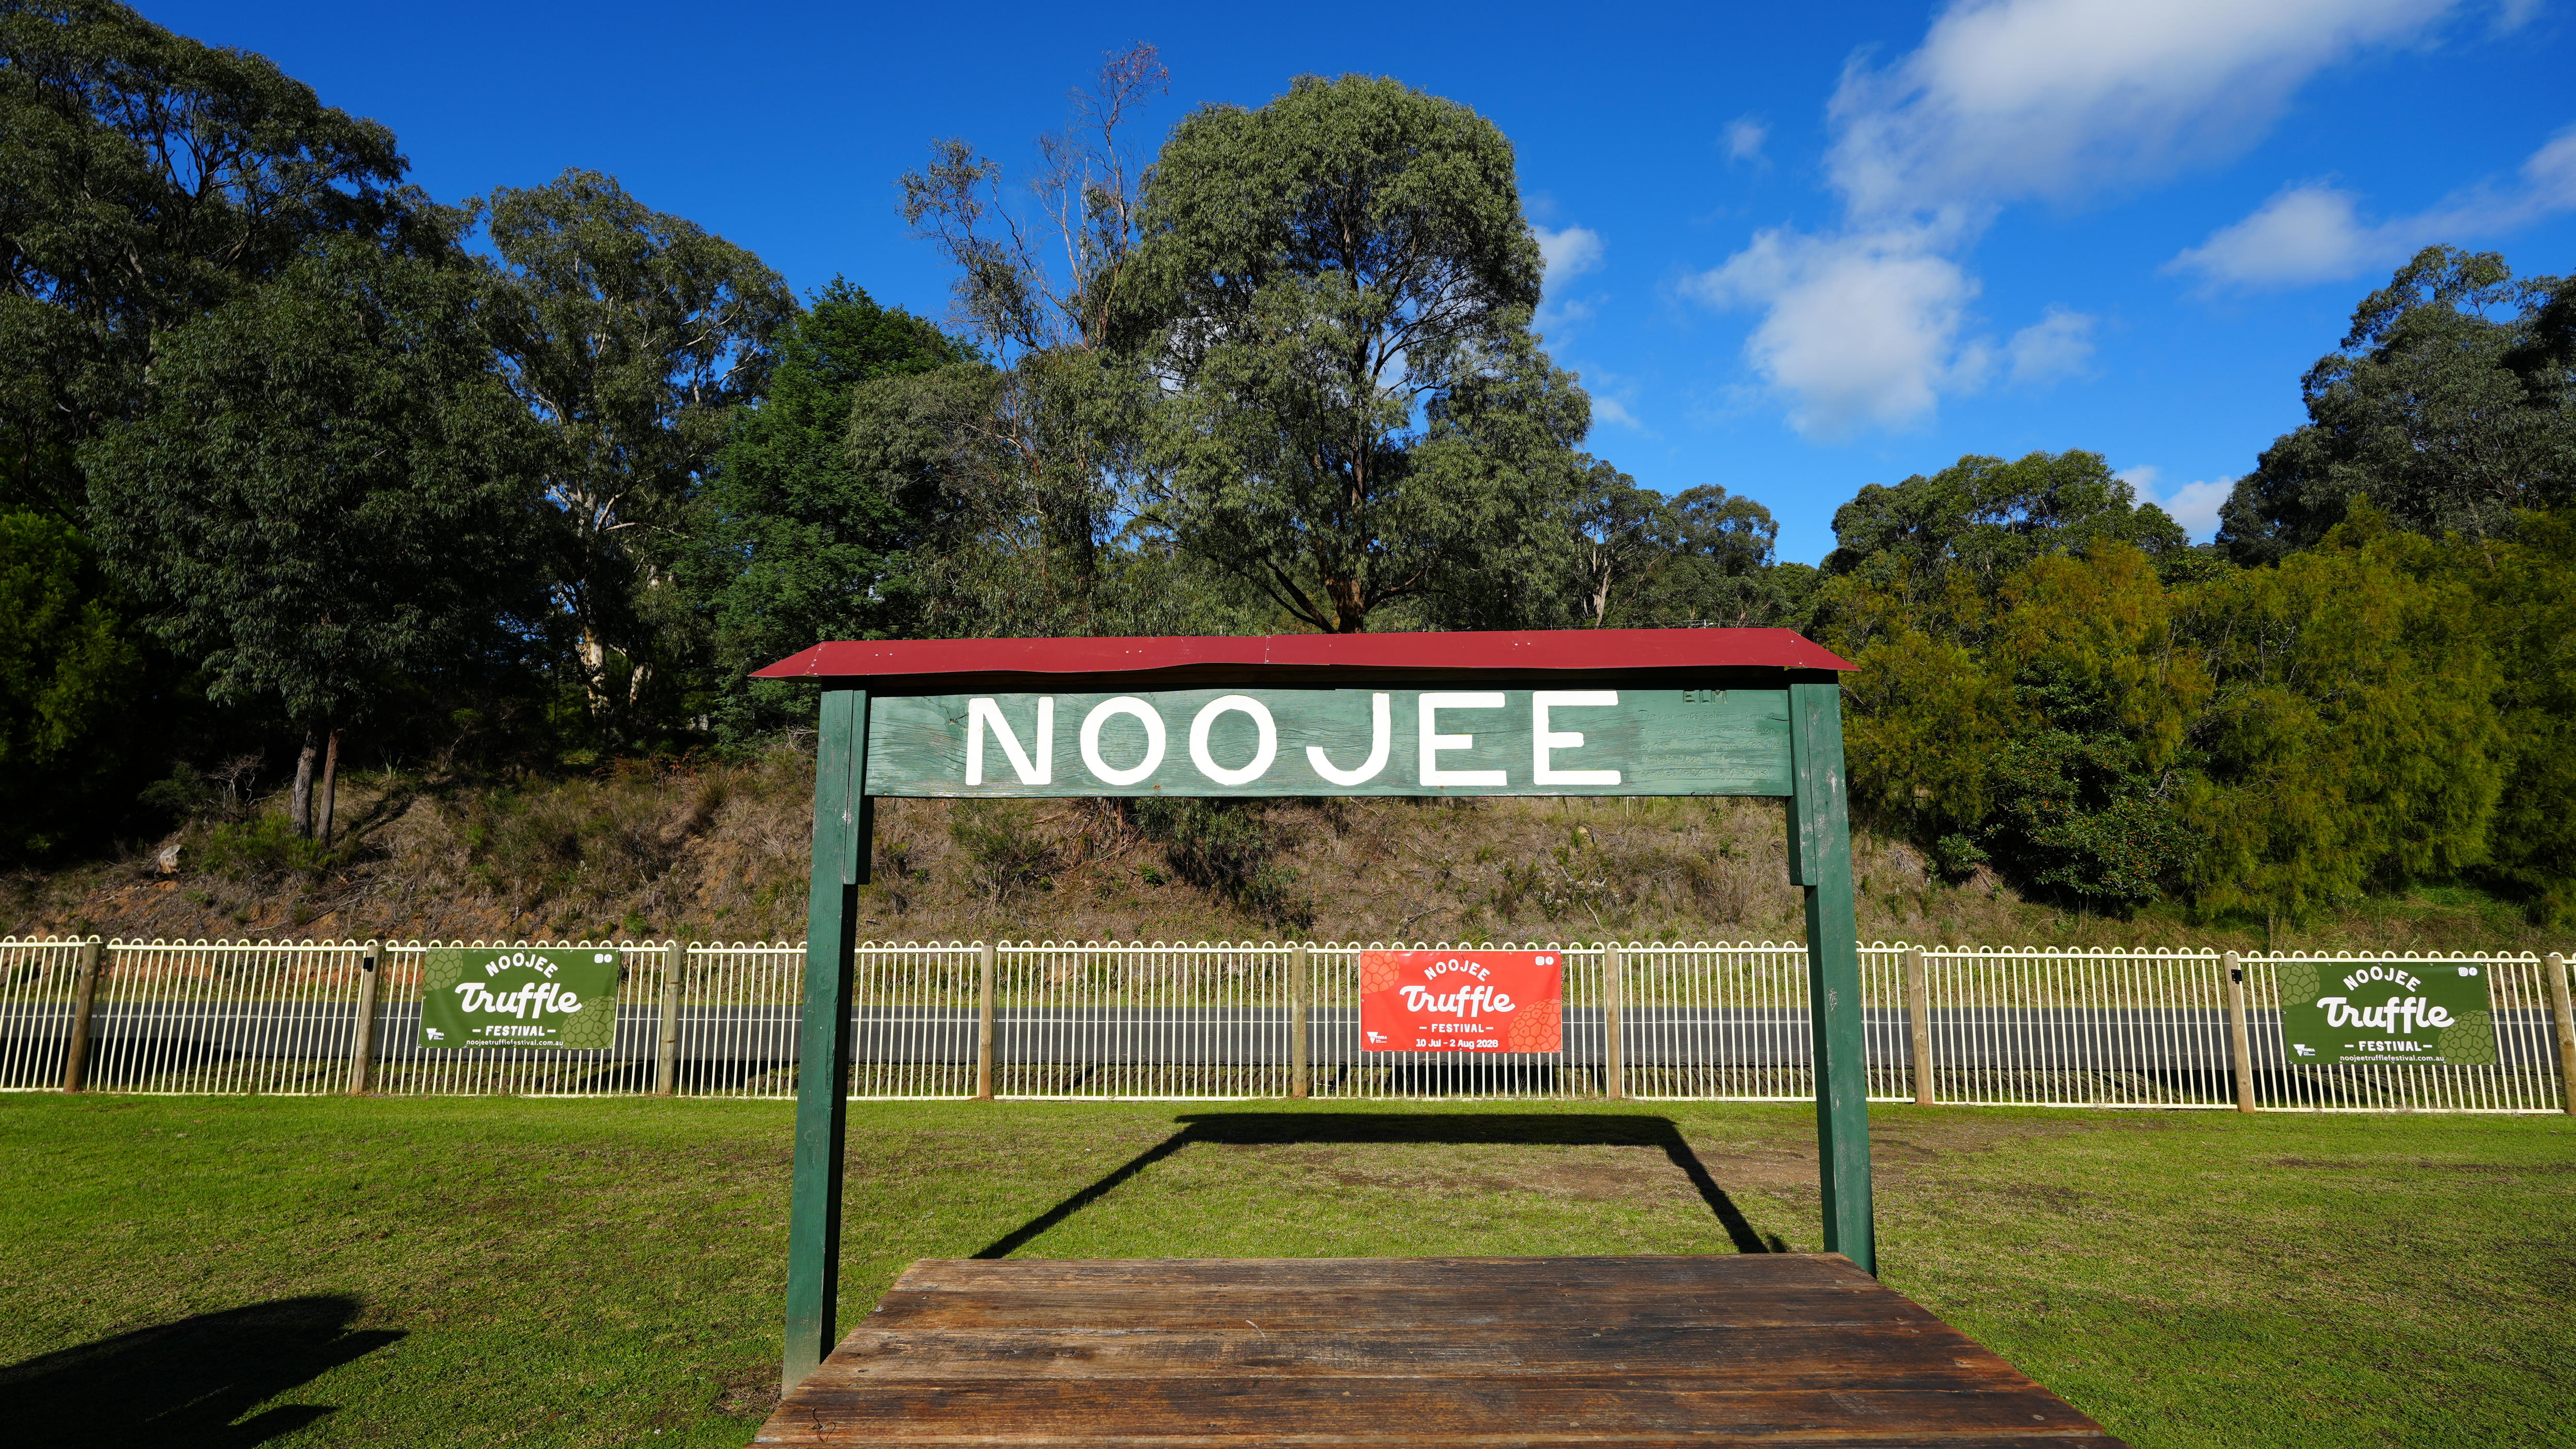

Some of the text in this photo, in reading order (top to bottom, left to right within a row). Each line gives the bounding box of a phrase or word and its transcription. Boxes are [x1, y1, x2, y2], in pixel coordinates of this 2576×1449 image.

[1683, 690, 1727, 705] ELM
[965, 691, 1621, 787] NOOJEE
[485, 952, 558, 979] NOOJEE
[1424, 959, 1490, 982] NOOJEE
[2343, 966, 2421, 993] NOOJEE
[454, 982, 583, 1019] Truffle
[1399, 985, 1516, 1018] Truffle
[2316, 996, 2455, 1034] Truffle
[485, 1025, 545, 1036] FESTIVAL
[1431, 1023, 1484, 1033] FESTIVAL
[466, 1038, 564, 1047] noojeetrufflefestival.com.au
[1415, 1038, 1427, 1047] 10
[1428, 1038, 1442, 1048] Jul
[1449, 1039, 1456, 1047] 2
[1457, 1039, 1475, 1050] Aug
[1476, 1039, 1499, 1048] 2026
[2358, 1041, 2422, 1052] FESTIVAL
